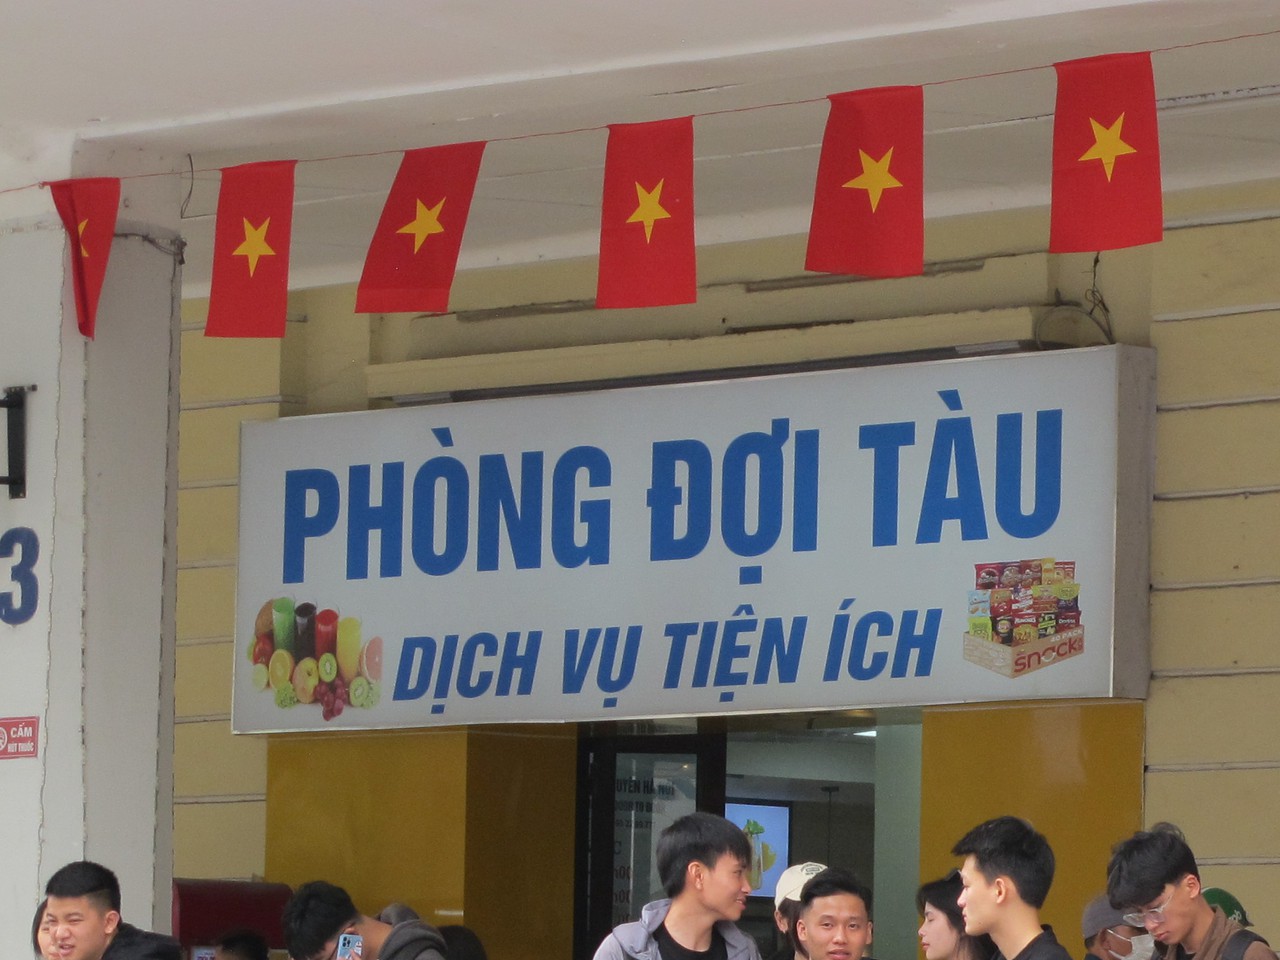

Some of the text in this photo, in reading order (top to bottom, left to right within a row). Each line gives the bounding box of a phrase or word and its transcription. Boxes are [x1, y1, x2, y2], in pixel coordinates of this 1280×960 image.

[283, 389, 1063, 585] PHÒNG ĐỢI TÀU
[0, 526, 40, 625] 3
[393, 598, 944, 714] DỊCH VỤ TIỆN ÍCH
[10, 722, 33, 738] CẤM
